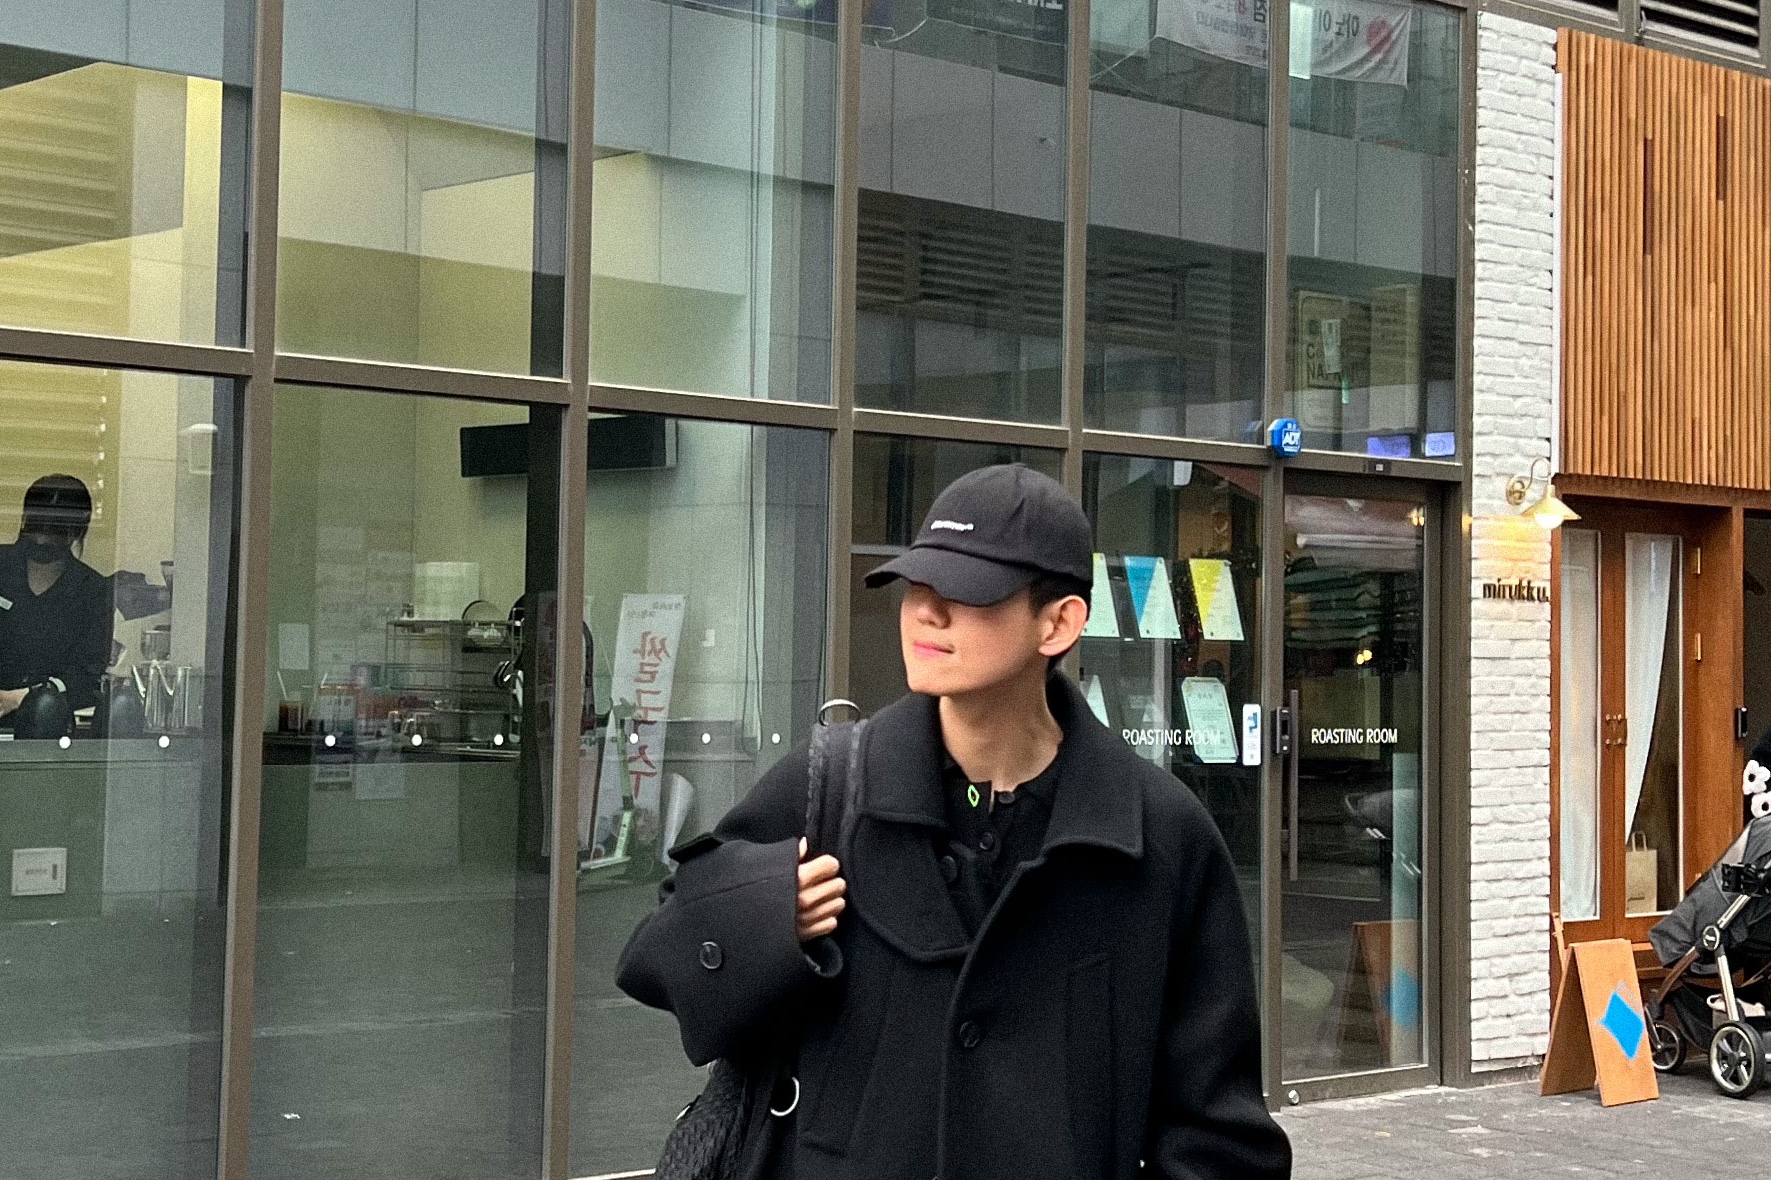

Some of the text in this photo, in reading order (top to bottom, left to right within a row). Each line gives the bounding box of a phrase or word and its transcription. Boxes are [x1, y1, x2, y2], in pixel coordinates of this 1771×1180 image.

[1122, 728, 1221, 746] ROASTING ROOM
[1311, 728, 1398, 744] ROASTING ROOM
